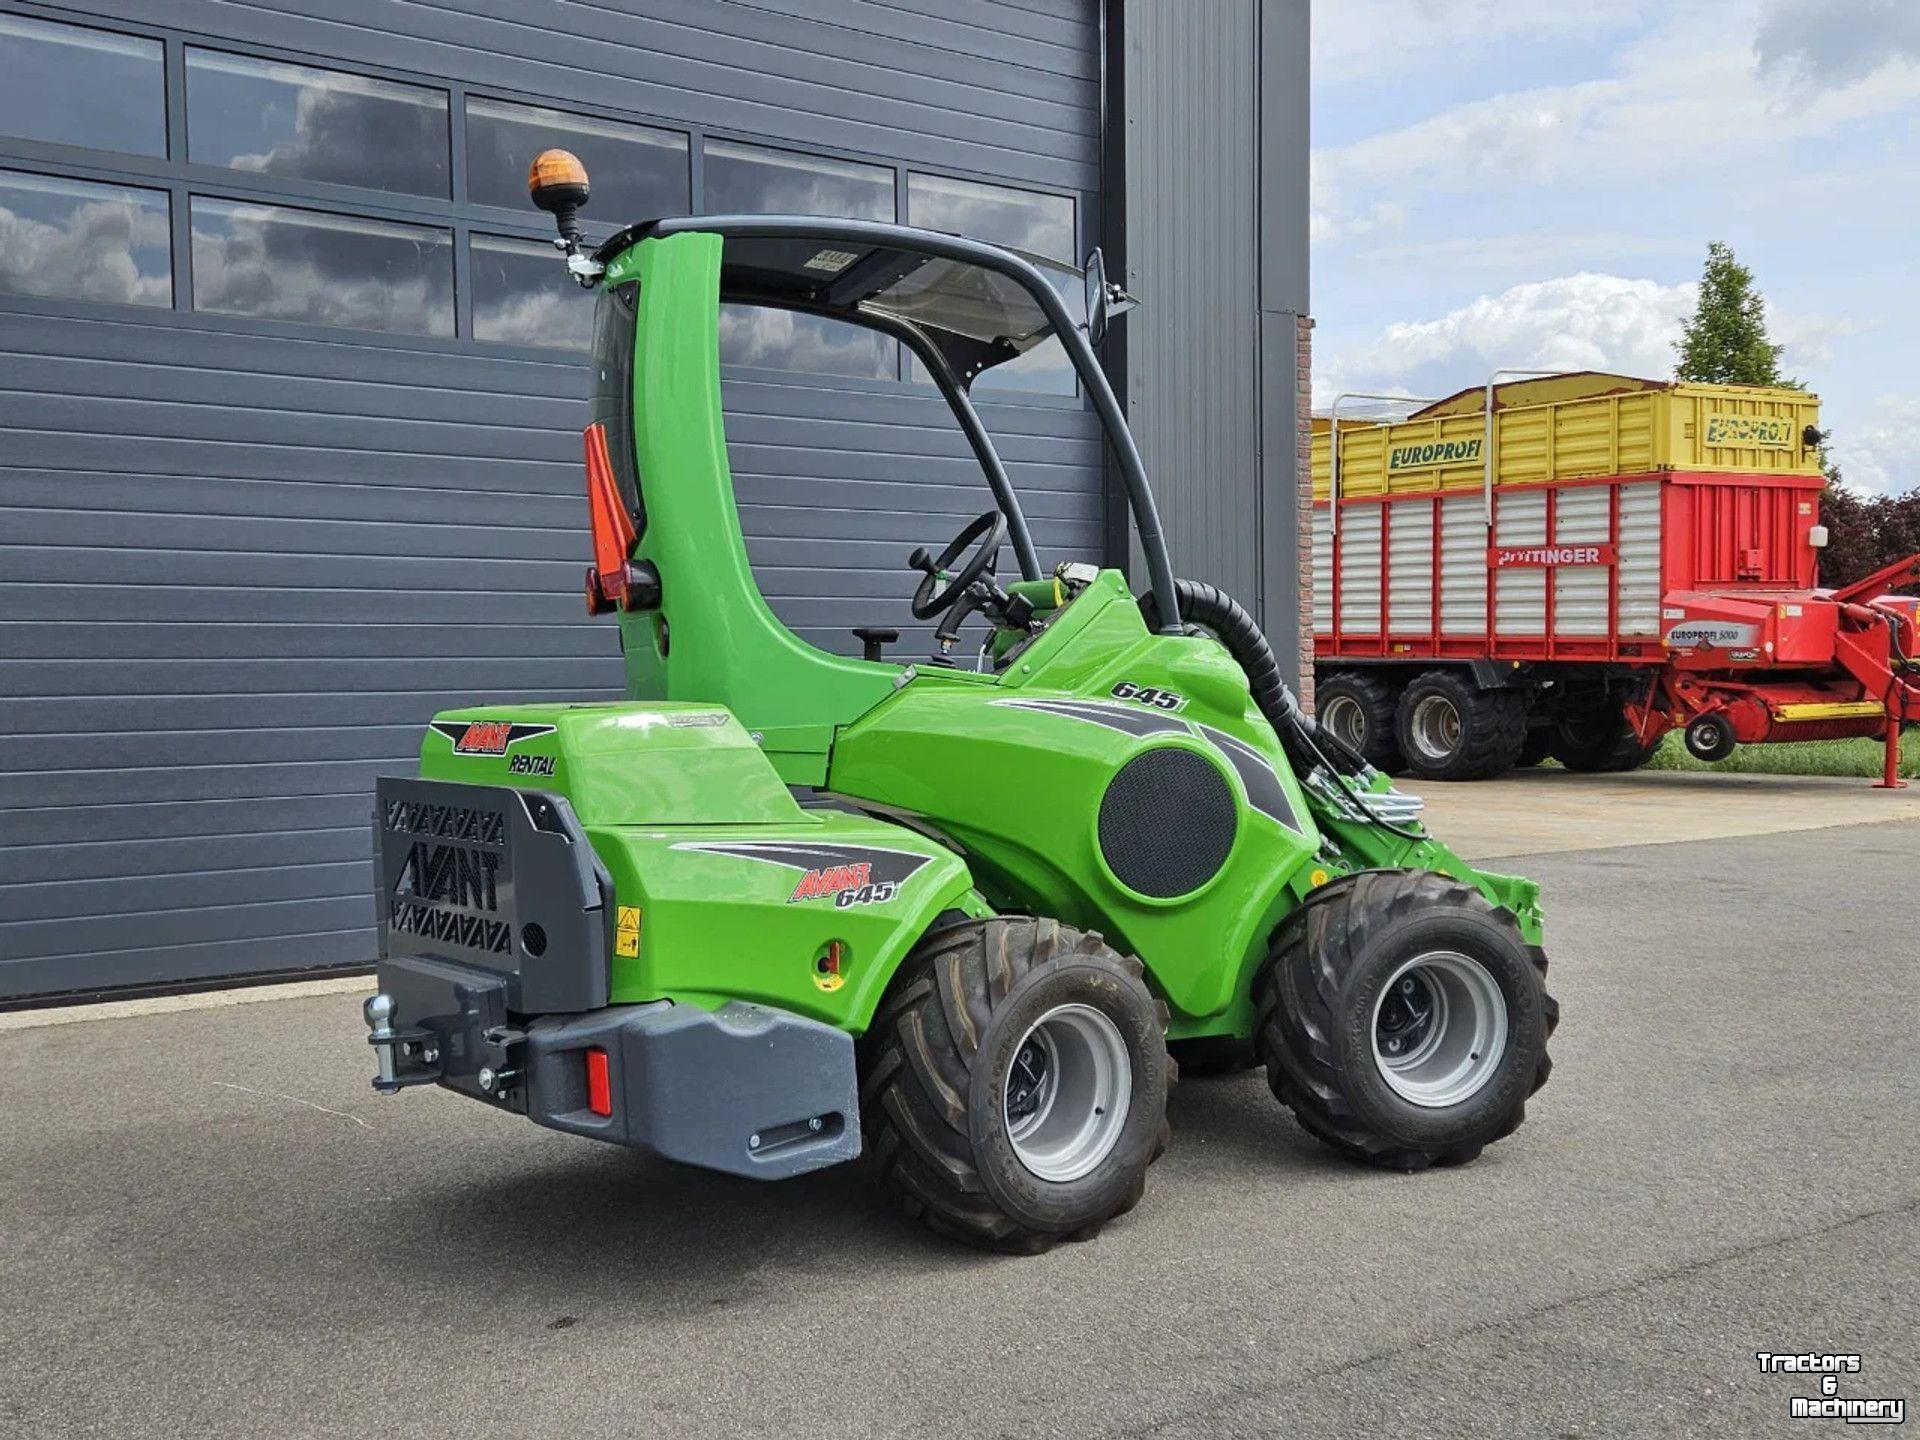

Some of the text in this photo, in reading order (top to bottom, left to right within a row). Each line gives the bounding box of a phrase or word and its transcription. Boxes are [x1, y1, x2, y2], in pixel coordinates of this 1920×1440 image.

[1390, 440, 1482, 469] EUROPROFI
[1671, 631, 1717, 640] EUROPROFI
[1110, 682, 1182, 710] 645
[456, 721, 512, 752] AVANT
[508, 755, 556, 776] RENTAL
[393, 841, 500, 912] AVANT
[788, 862, 872, 903] AVANT
[835, 881, 896, 909] 645
